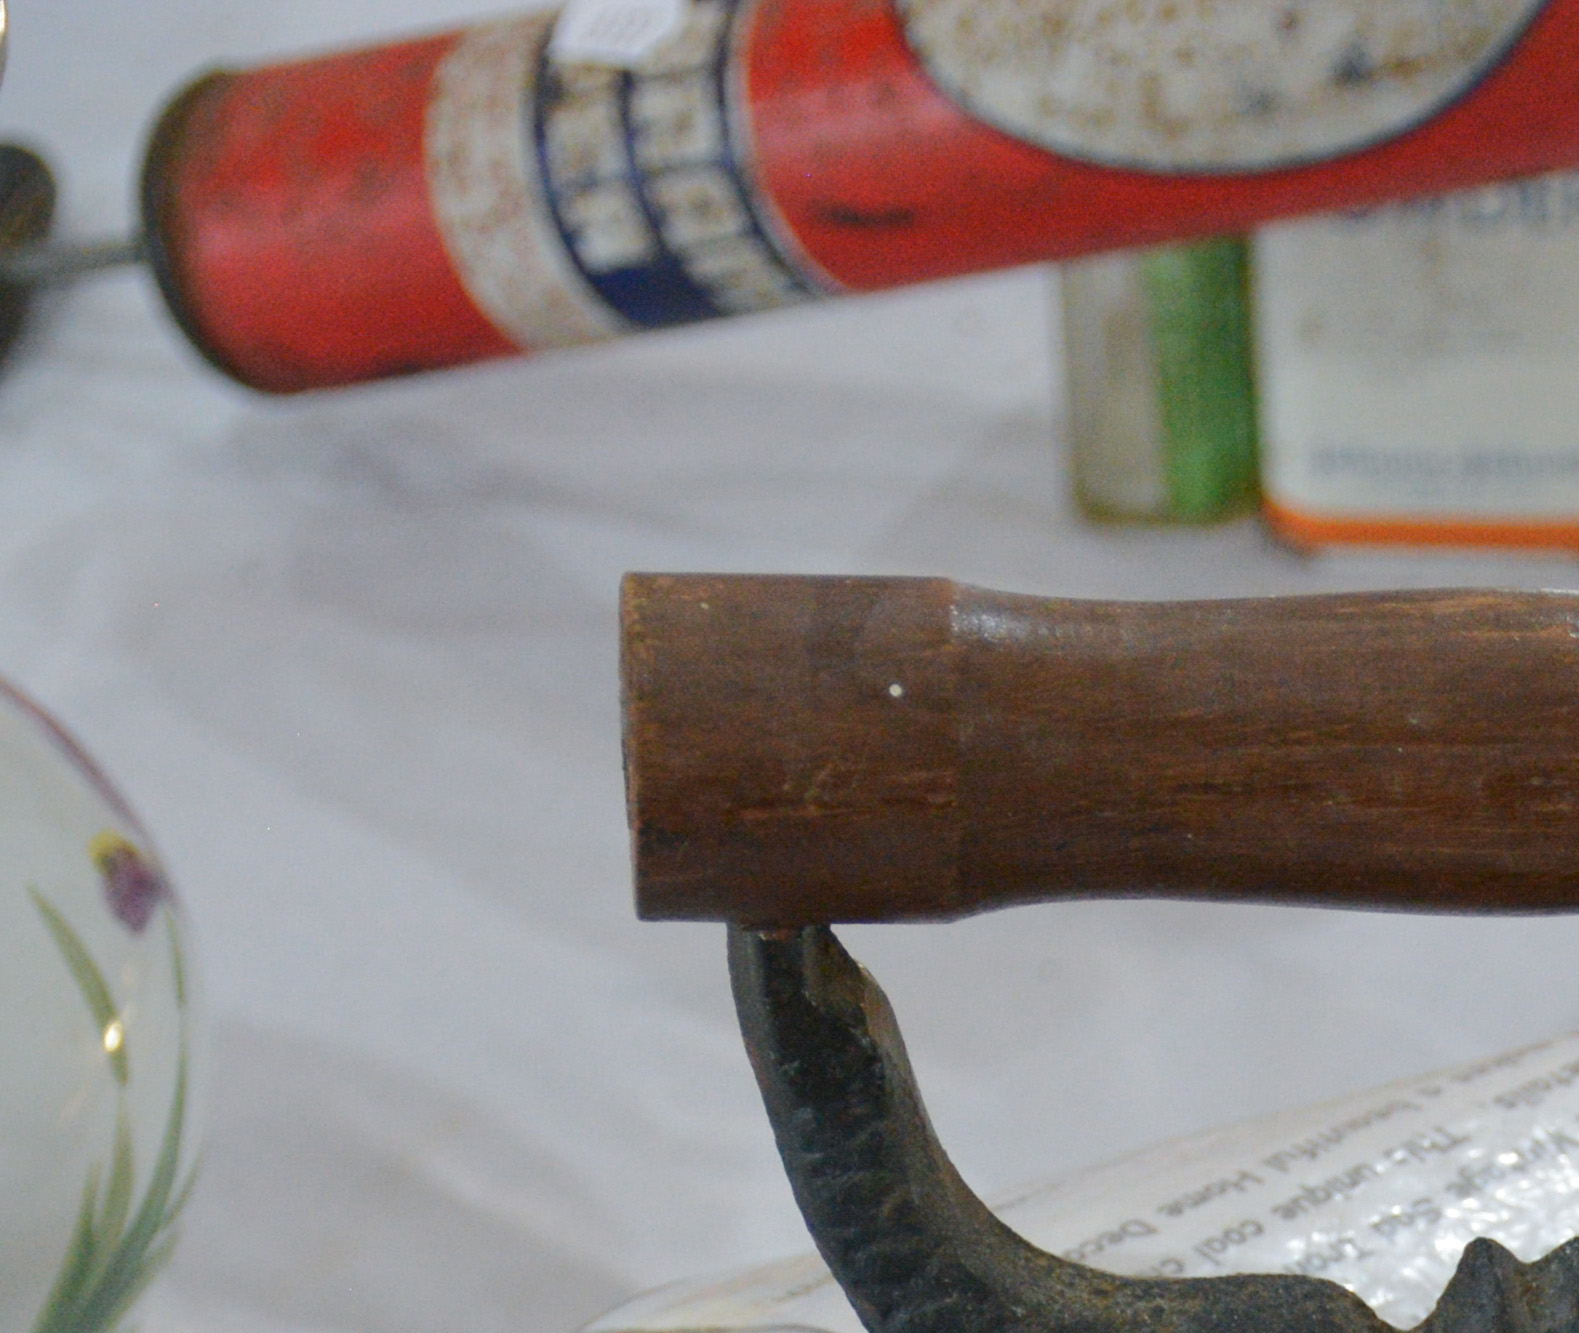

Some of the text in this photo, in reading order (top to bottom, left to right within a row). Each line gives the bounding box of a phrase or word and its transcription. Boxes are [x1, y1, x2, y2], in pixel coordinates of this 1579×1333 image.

[1156, 1171, 1266, 1219] Home
[1270, 1162, 1379, 1222] unique
[1192, 1219, 1265, 1267] coal
[1370, 1198, 1442, 1244] Sad
